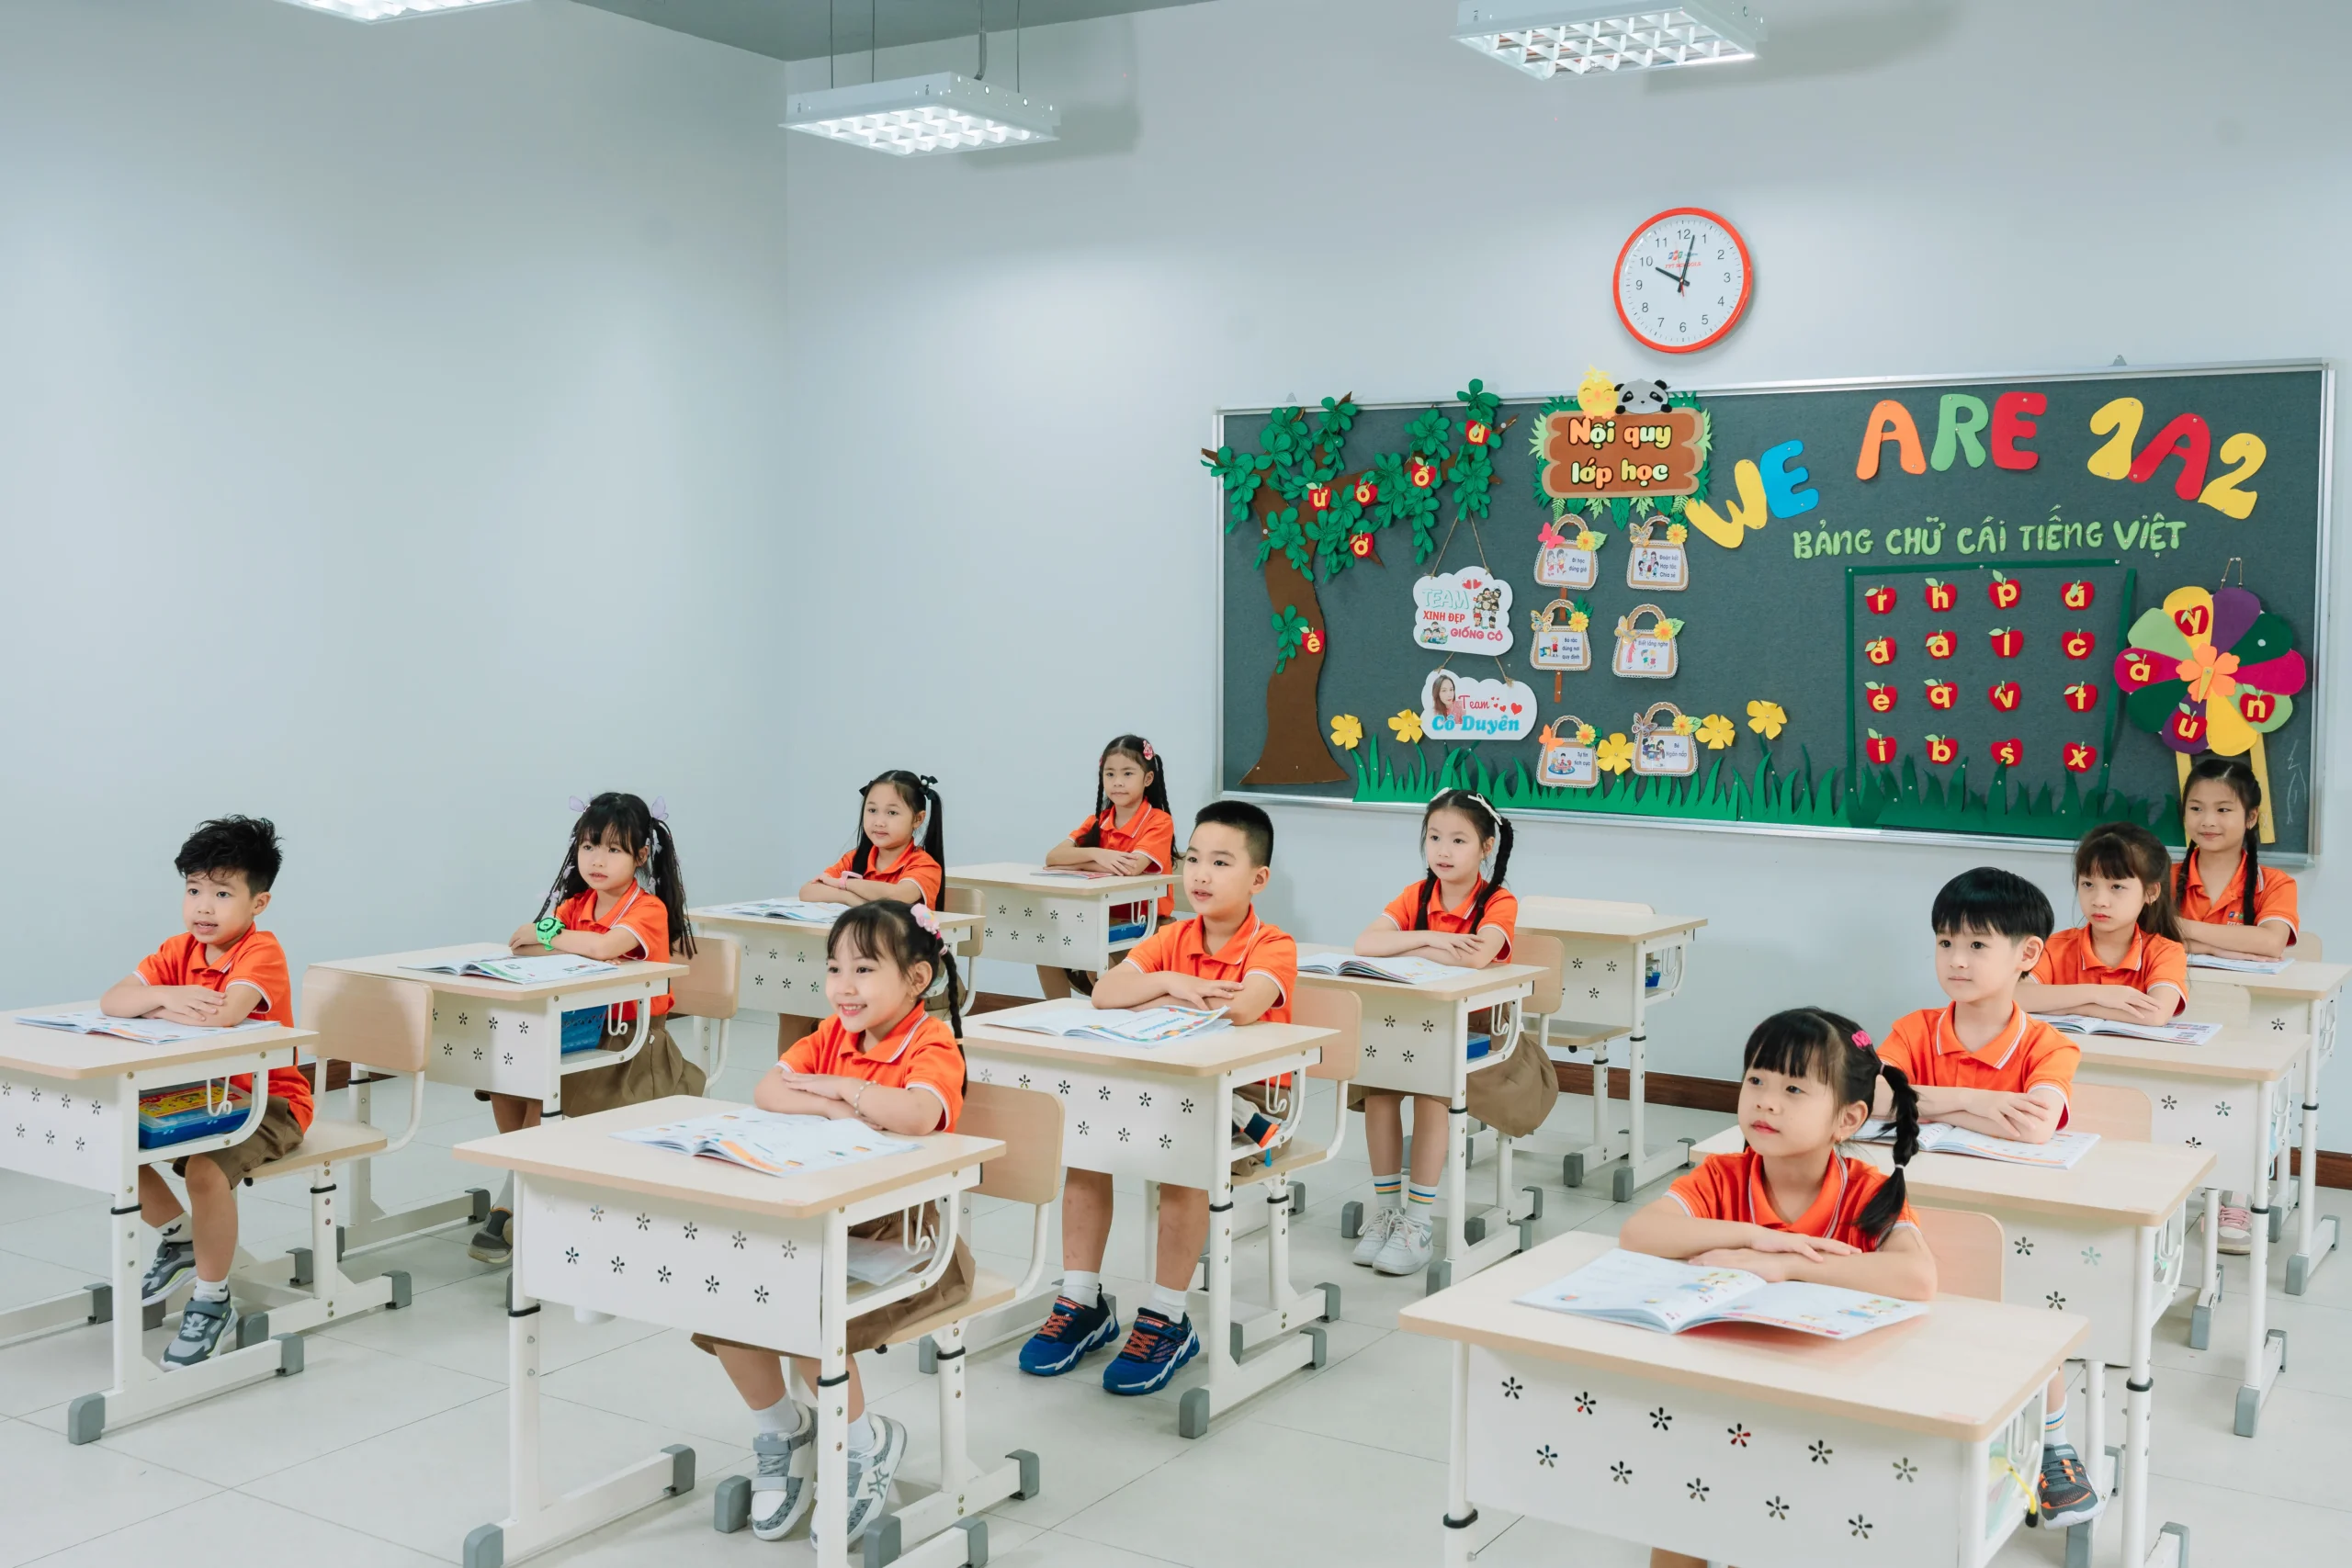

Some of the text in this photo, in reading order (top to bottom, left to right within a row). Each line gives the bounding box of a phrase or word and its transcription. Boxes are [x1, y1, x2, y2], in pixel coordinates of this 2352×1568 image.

[1655, 237, 1668, 248] 11
[1677, 229, 1690, 240] 12
[1640, 255, 1654, 267] 10
[1717, 249, 1724, 260] 2
[1635, 279, 1643, 290] 9
[1724, 272, 1731, 283] 3
[1642, 302, 1649, 313] 8
[1717, 296, 1724, 307] 4
[1657, 317, 1665, 328] 7
[1679, 321, 1687, 333] 6
[1702, 314, 1709, 325] 5
[1568, 417, 1672, 449] Nội quy
[1571, 457, 1669, 490] lớp học
[1684, 391, 2267, 548] WE ARE 1A2
[1314, 490, 1329, 507] ư
[1885, 516, 1946, 555] CHỮ
[1353, 537, 1369, 556] ơ
[1422, 588, 1470, 609] TEAM
[1877, 594, 1887, 611] r
[1932, 587, 1949, 609] h
[1996, 583, 2017, 607] p
[1423, 610, 1465, 624] XINH ĐẸP
[2186, 610, 2202, 634] y
[1306, 633, 1320, 653] ê
[1451, 626, 1503, 641] GIỐNG CÔ
[2067, 638, 2086, 657] c
[2130, 662, 2151, 682] a
[1458, 694, 1490, 710] Team
[1872, 686, 2086, 711] e q v t
[2246, 699, 2266, 718] n
[1431, 714, 1520, 735] Cô Duyên
[2178, 717, 2199, 739] u
[1931, 740, 1951, 761] b
[2000, 747, 2015, 764] s
[2067, 749, 2088, 769] x
